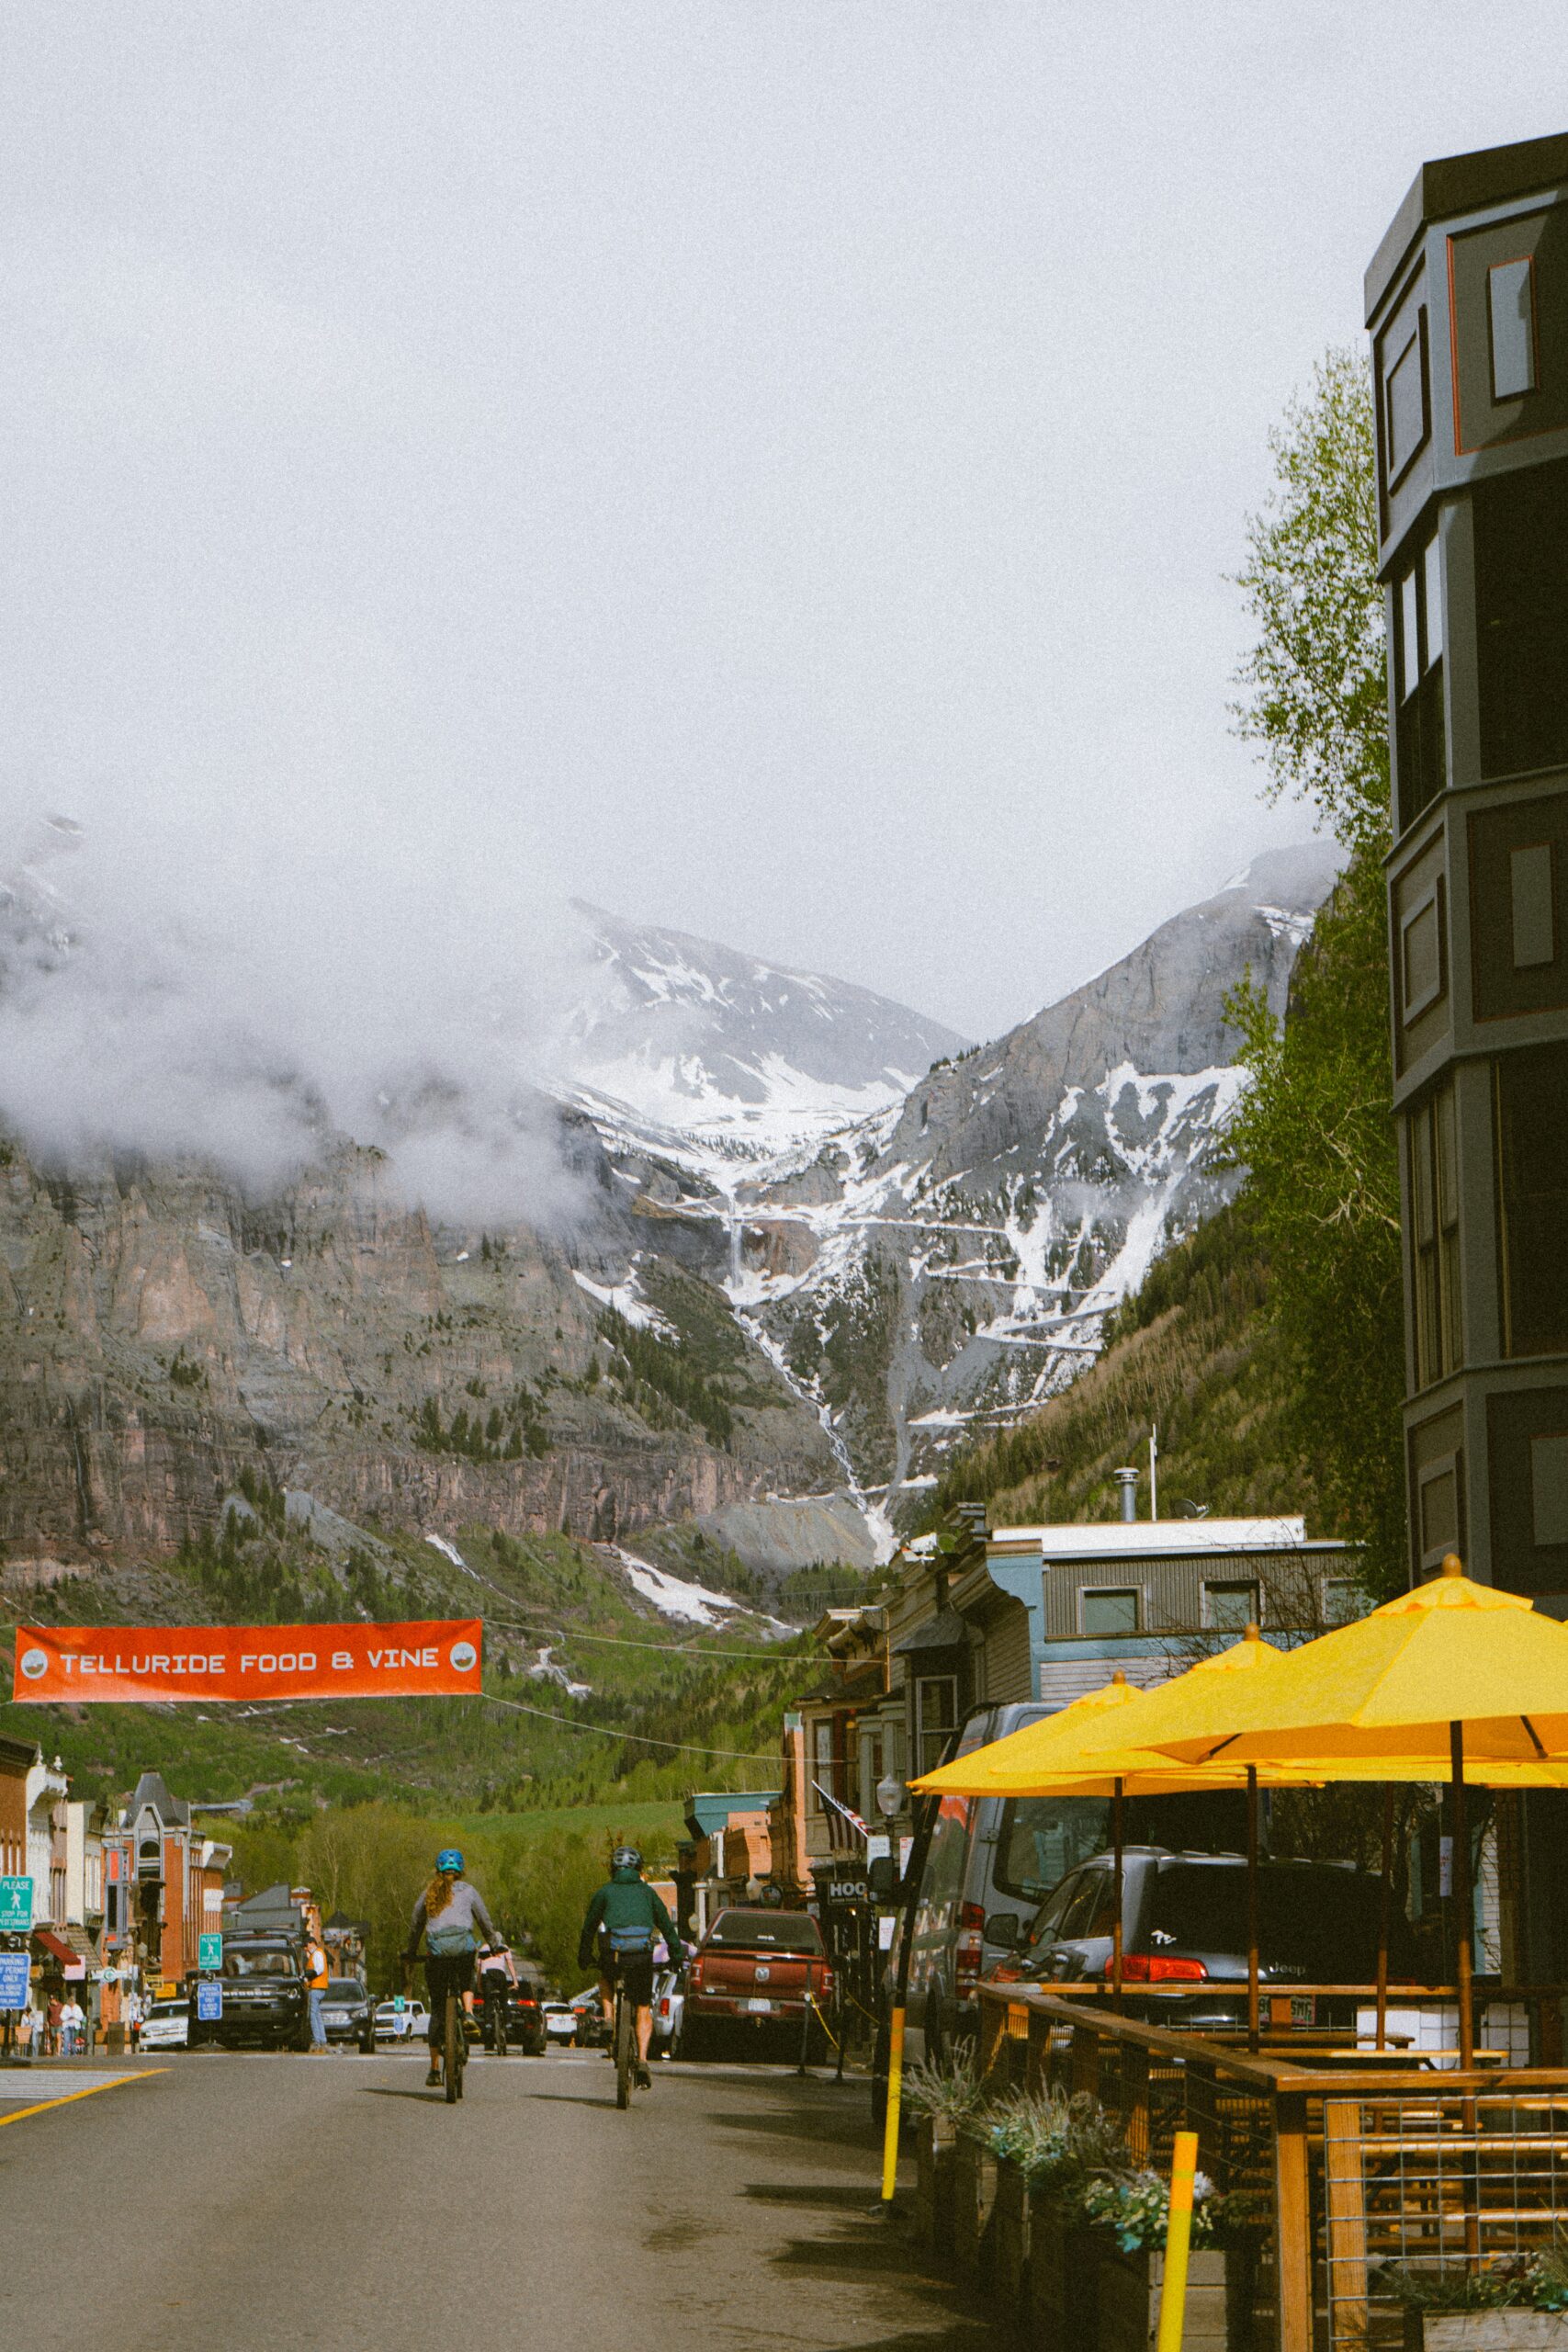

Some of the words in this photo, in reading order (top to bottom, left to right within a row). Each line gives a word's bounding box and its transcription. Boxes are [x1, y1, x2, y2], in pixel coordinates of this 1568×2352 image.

[60, 1654, 226, 1674] TELLURIDE
[241, 1653, 317, 1673] FOOD
[332, 1651, 354, 1669] &
[367, 1647, 439, 1668] VINE
[2, 1881, 29, 1890] PLEASE
[829, 1882, 867, 1896] HOO
[1, 1910, 15, 1918] STOP
[17, 1910, 28, 1918] FOR
[1269, 1962, 1305, 1976] Jeep
